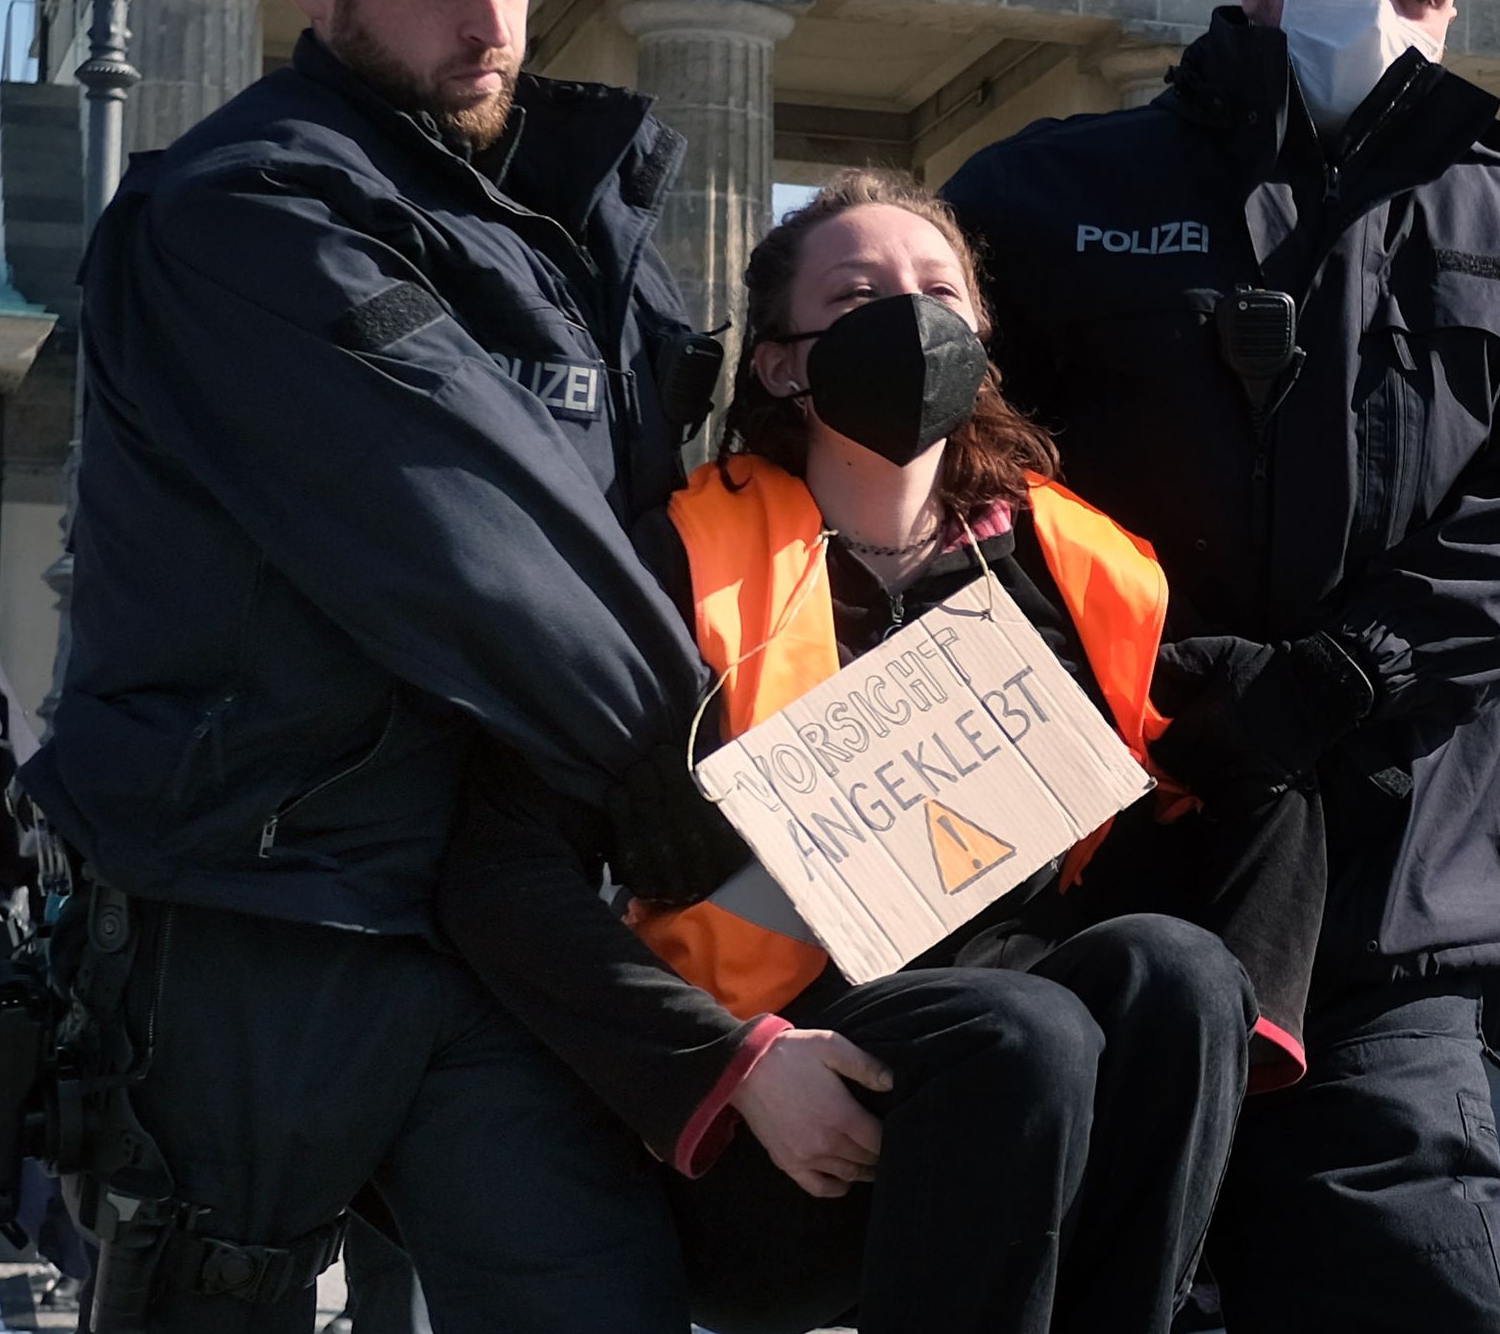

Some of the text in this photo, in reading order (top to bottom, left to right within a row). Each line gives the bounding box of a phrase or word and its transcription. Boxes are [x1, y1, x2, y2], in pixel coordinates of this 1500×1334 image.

[1076, 221, 1209, 255] POLIZEI
[733, 626, 972, 813] VORSICHT
[786, 665, 1051, 882] ANGEKLEBT
